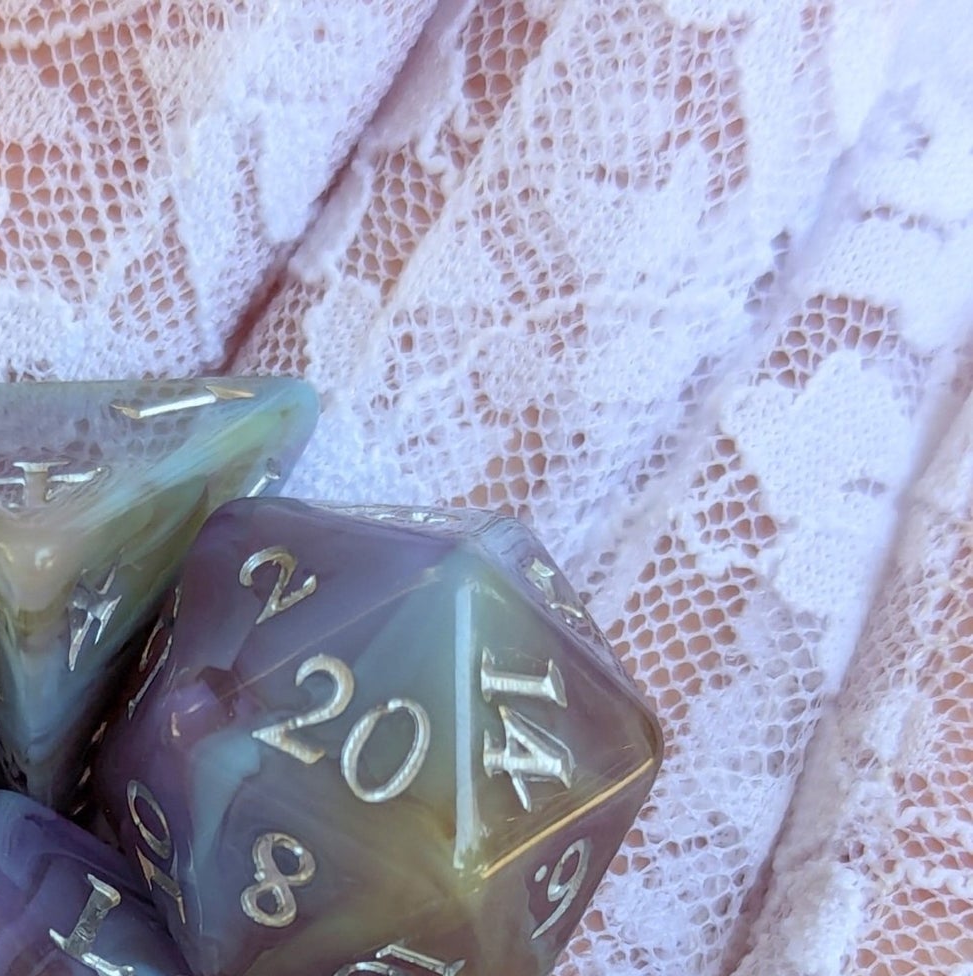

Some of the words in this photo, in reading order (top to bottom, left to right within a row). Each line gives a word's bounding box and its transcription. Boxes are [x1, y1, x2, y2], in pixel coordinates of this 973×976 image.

[239, 546, 317, 625] 2
[252, 654, 431, 804] 20
[480, 646, 574, 813] 14
[240, 832, 316, 928] 8
